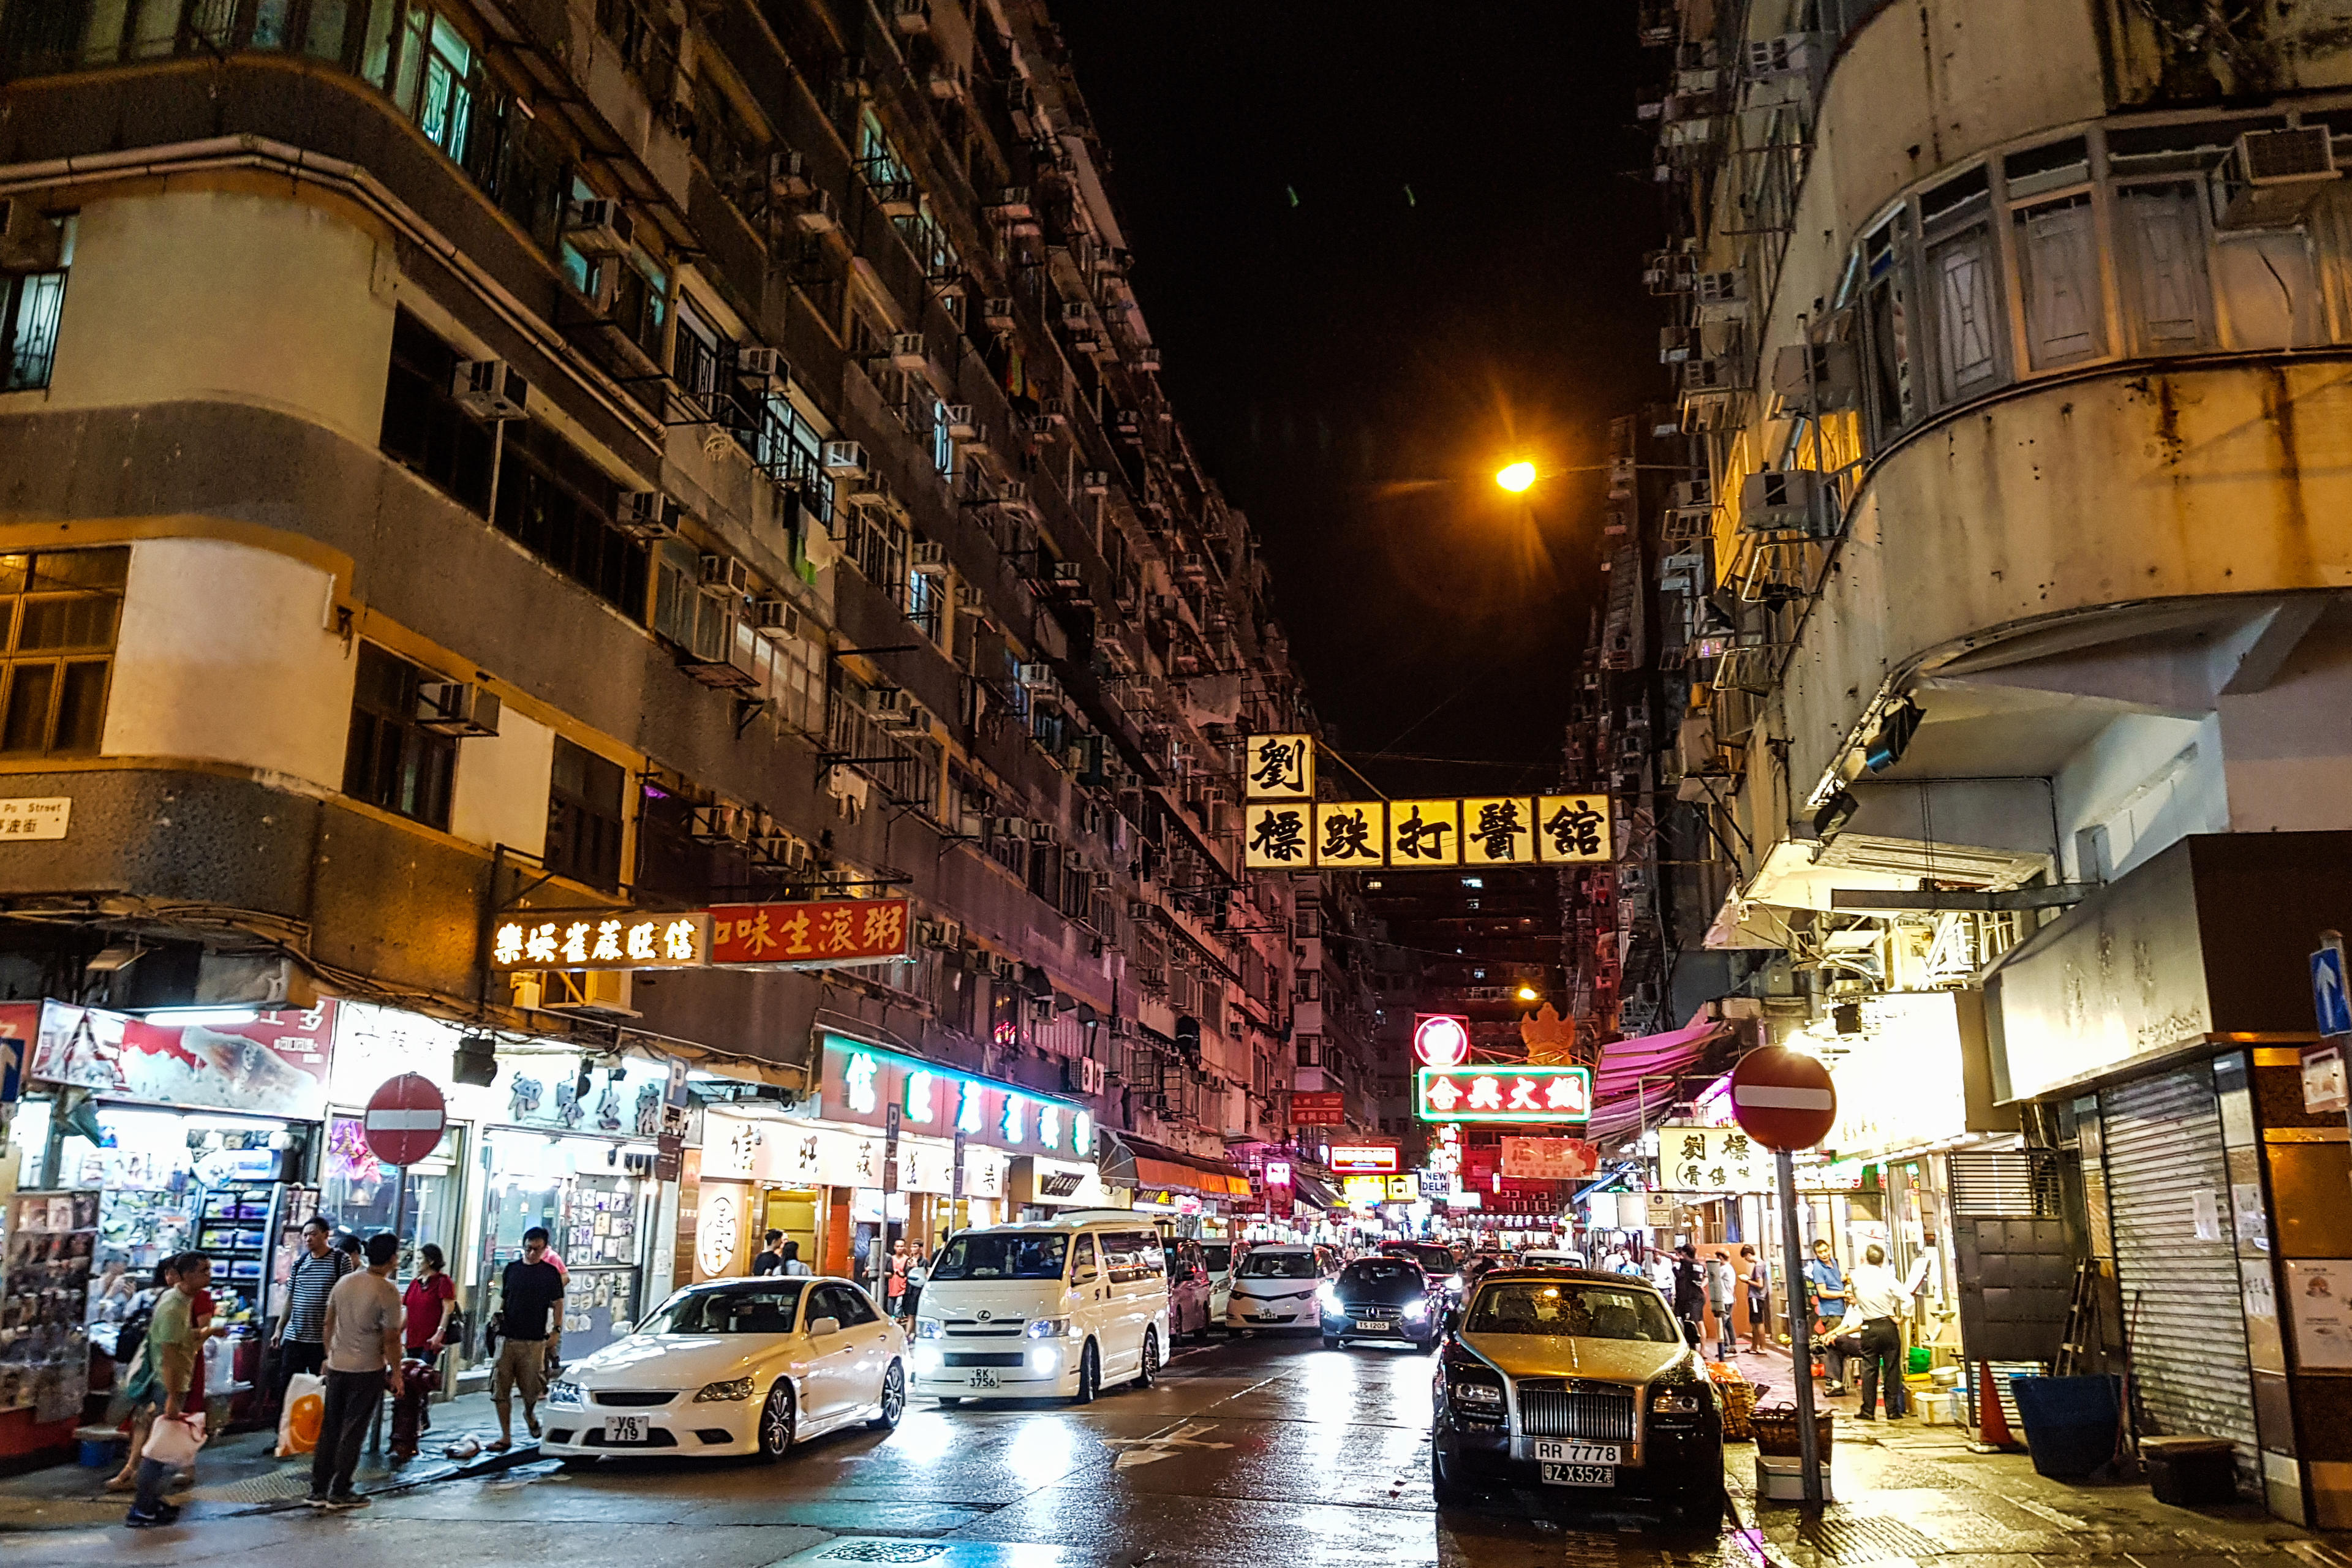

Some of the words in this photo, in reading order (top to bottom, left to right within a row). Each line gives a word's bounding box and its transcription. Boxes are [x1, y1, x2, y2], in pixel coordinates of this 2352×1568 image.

[1250, 739, 1305, 793] 劉
[28, 802, 61, 813] Street
[1426, 1172, 1447, 1181] NEW
[976, 1368, 989, 1378] RK
[970, 1378, 995, 1387] 3756
[617, 1416, 636, 1428] VG
[614, 1428, 638, 1440] 719
[1539, 1443, 1562, 1459] RR
[1570, 1445, 1616, 1461] 7778
